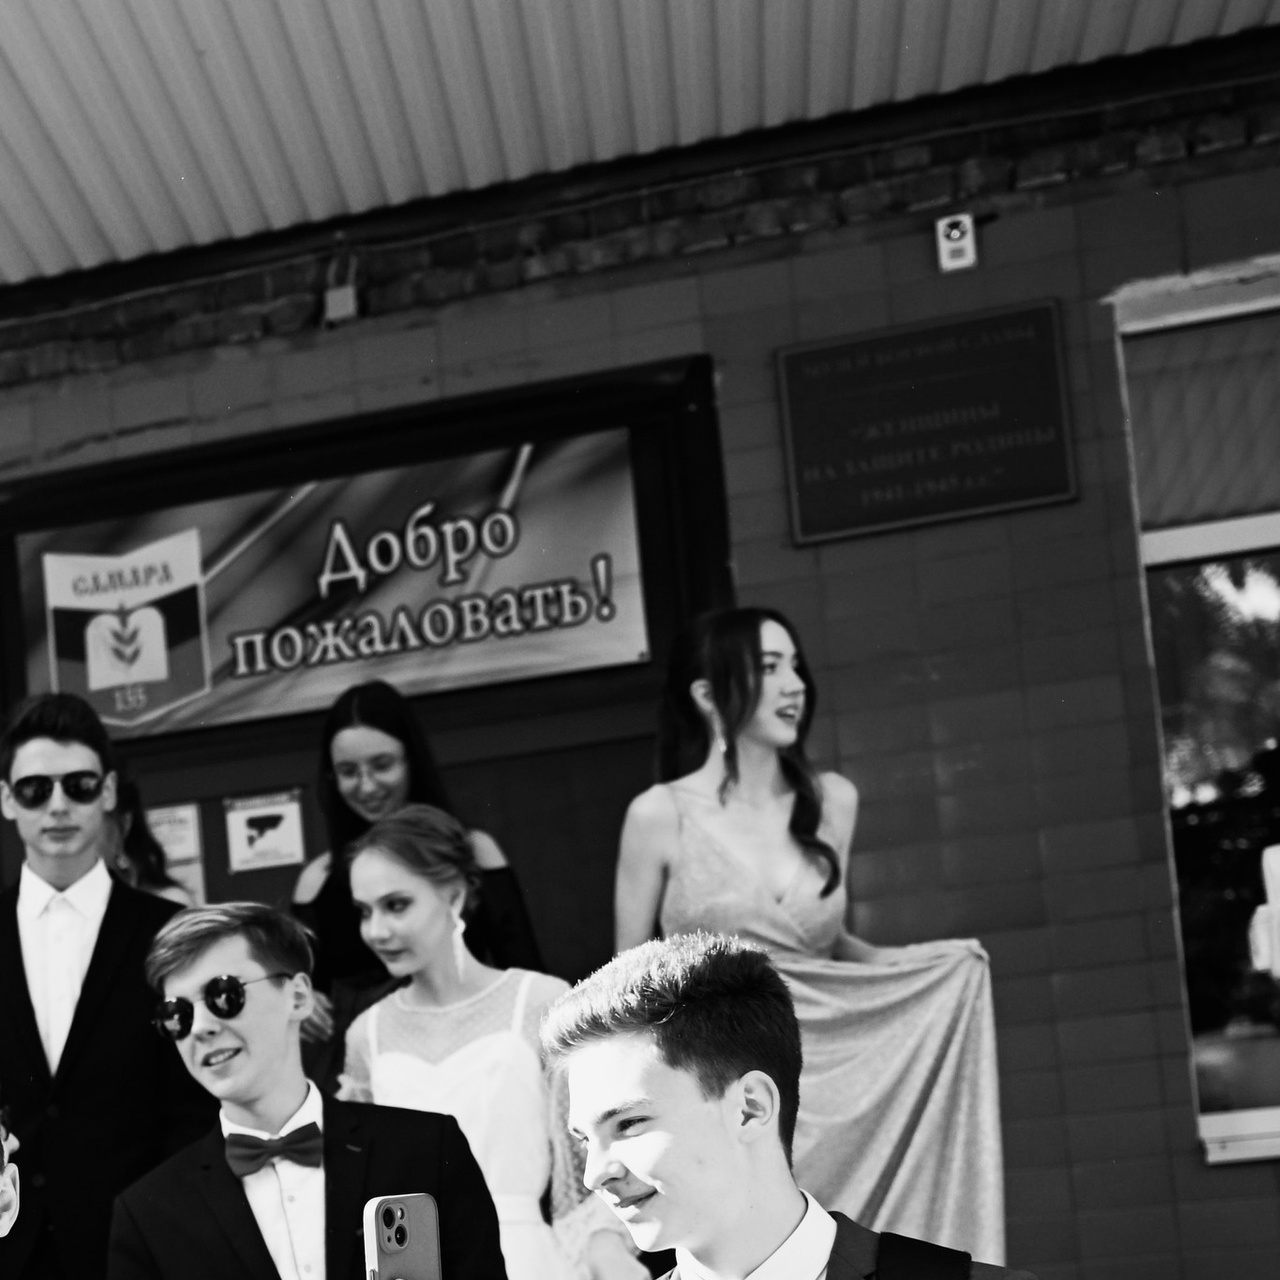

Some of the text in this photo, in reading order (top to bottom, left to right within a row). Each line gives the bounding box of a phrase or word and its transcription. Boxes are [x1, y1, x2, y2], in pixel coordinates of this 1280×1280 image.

[71, 562, 173, 598] САМАРА
[318, 503, 516, 597] Добро
[232, 558, 616, 676] пожаловать!
